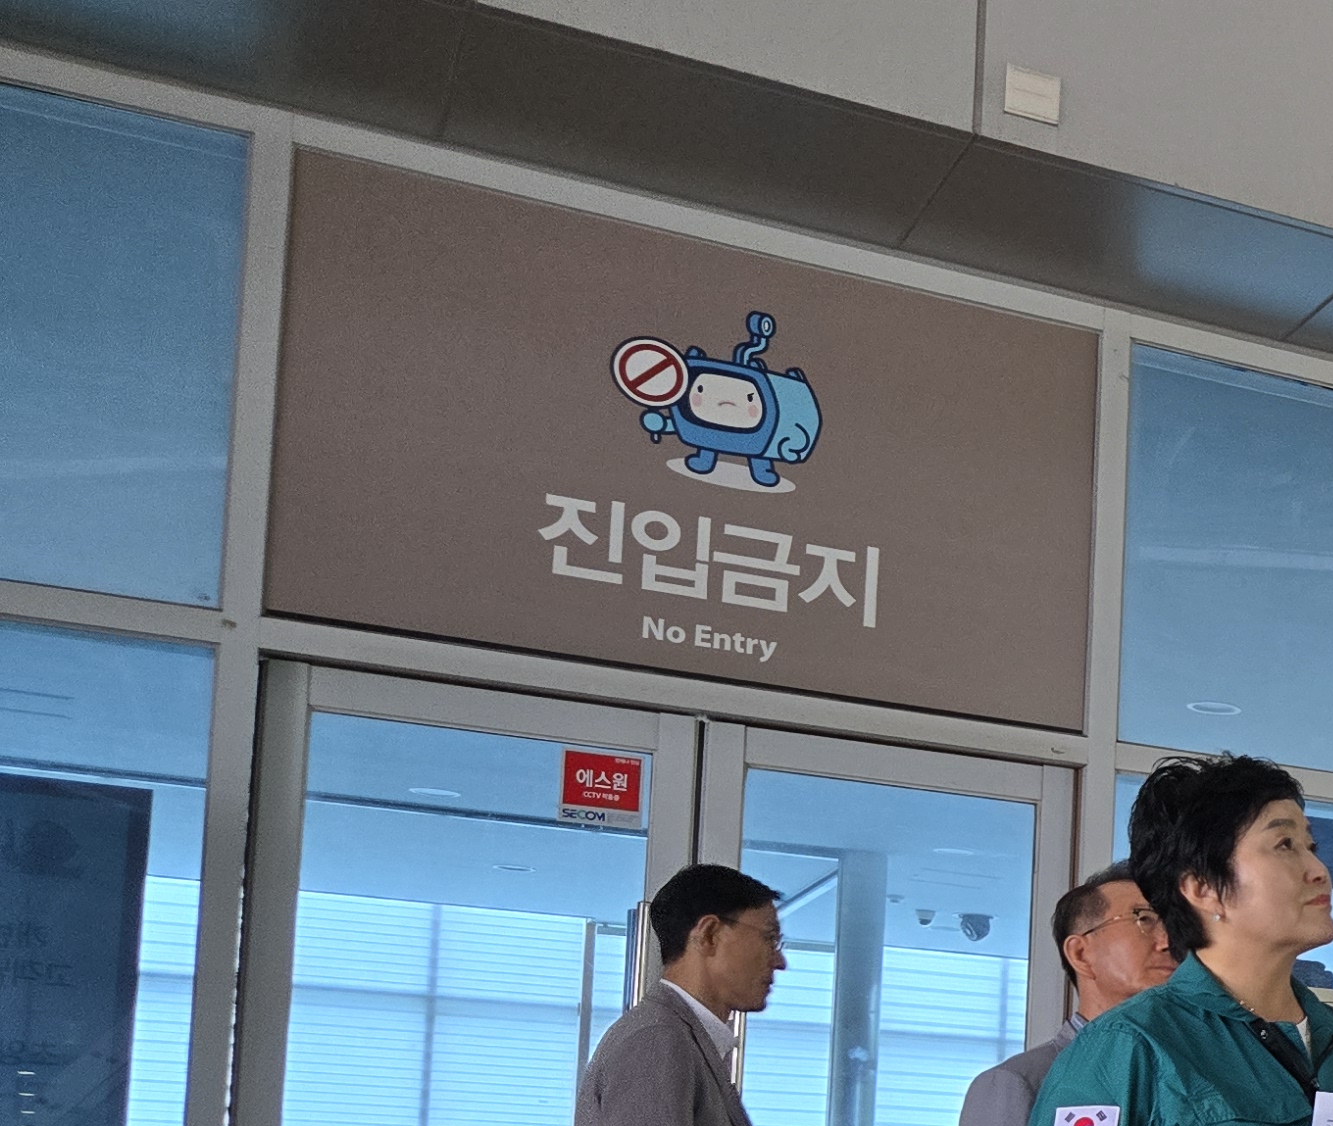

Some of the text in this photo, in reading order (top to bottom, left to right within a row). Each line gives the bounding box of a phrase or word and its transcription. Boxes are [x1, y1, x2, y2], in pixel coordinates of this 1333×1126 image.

[537, 492, 880, 628] 진입금지
[641, 614, 778, 664] No Entry
[575, 768, 628, 792] 에스원
[583, 791, 602, 799] CCTV
[562, 808, 606, 822] SECOM
